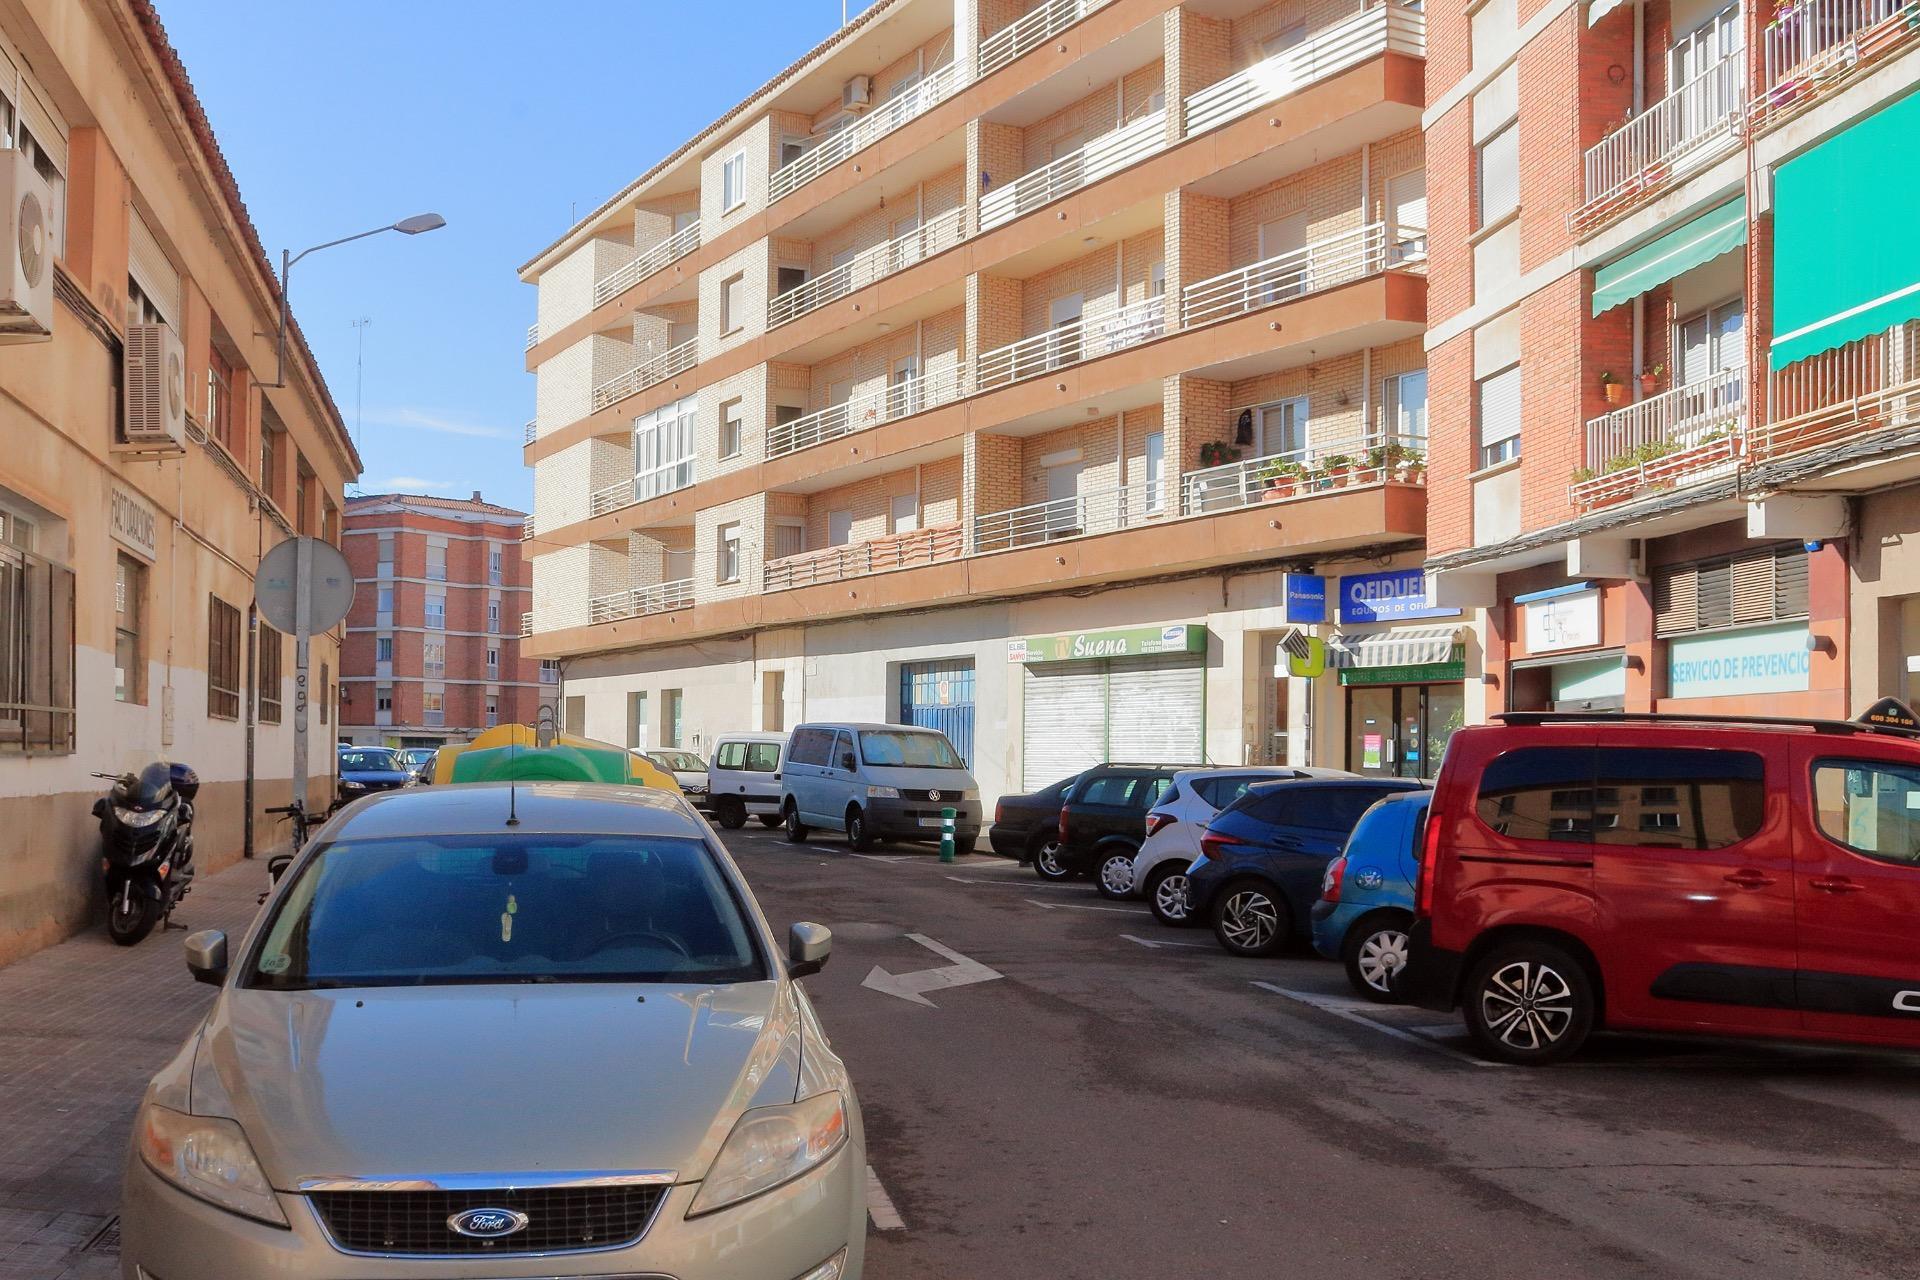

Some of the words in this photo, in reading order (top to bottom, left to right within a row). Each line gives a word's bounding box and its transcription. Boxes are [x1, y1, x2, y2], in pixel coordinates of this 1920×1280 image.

[1289, 591, 1325, 600] Panasonic
[1351, 605, 1391, 616] EQUIPOS
[1394, 603, 1406, 612] DE
[1008, 651, 1026, 661] SANYO
[1672, 658, 1721, 682] SERVICIO
[1724, 657, 1739, 679] DE
[469, 1214, 505, 1230] Ford
